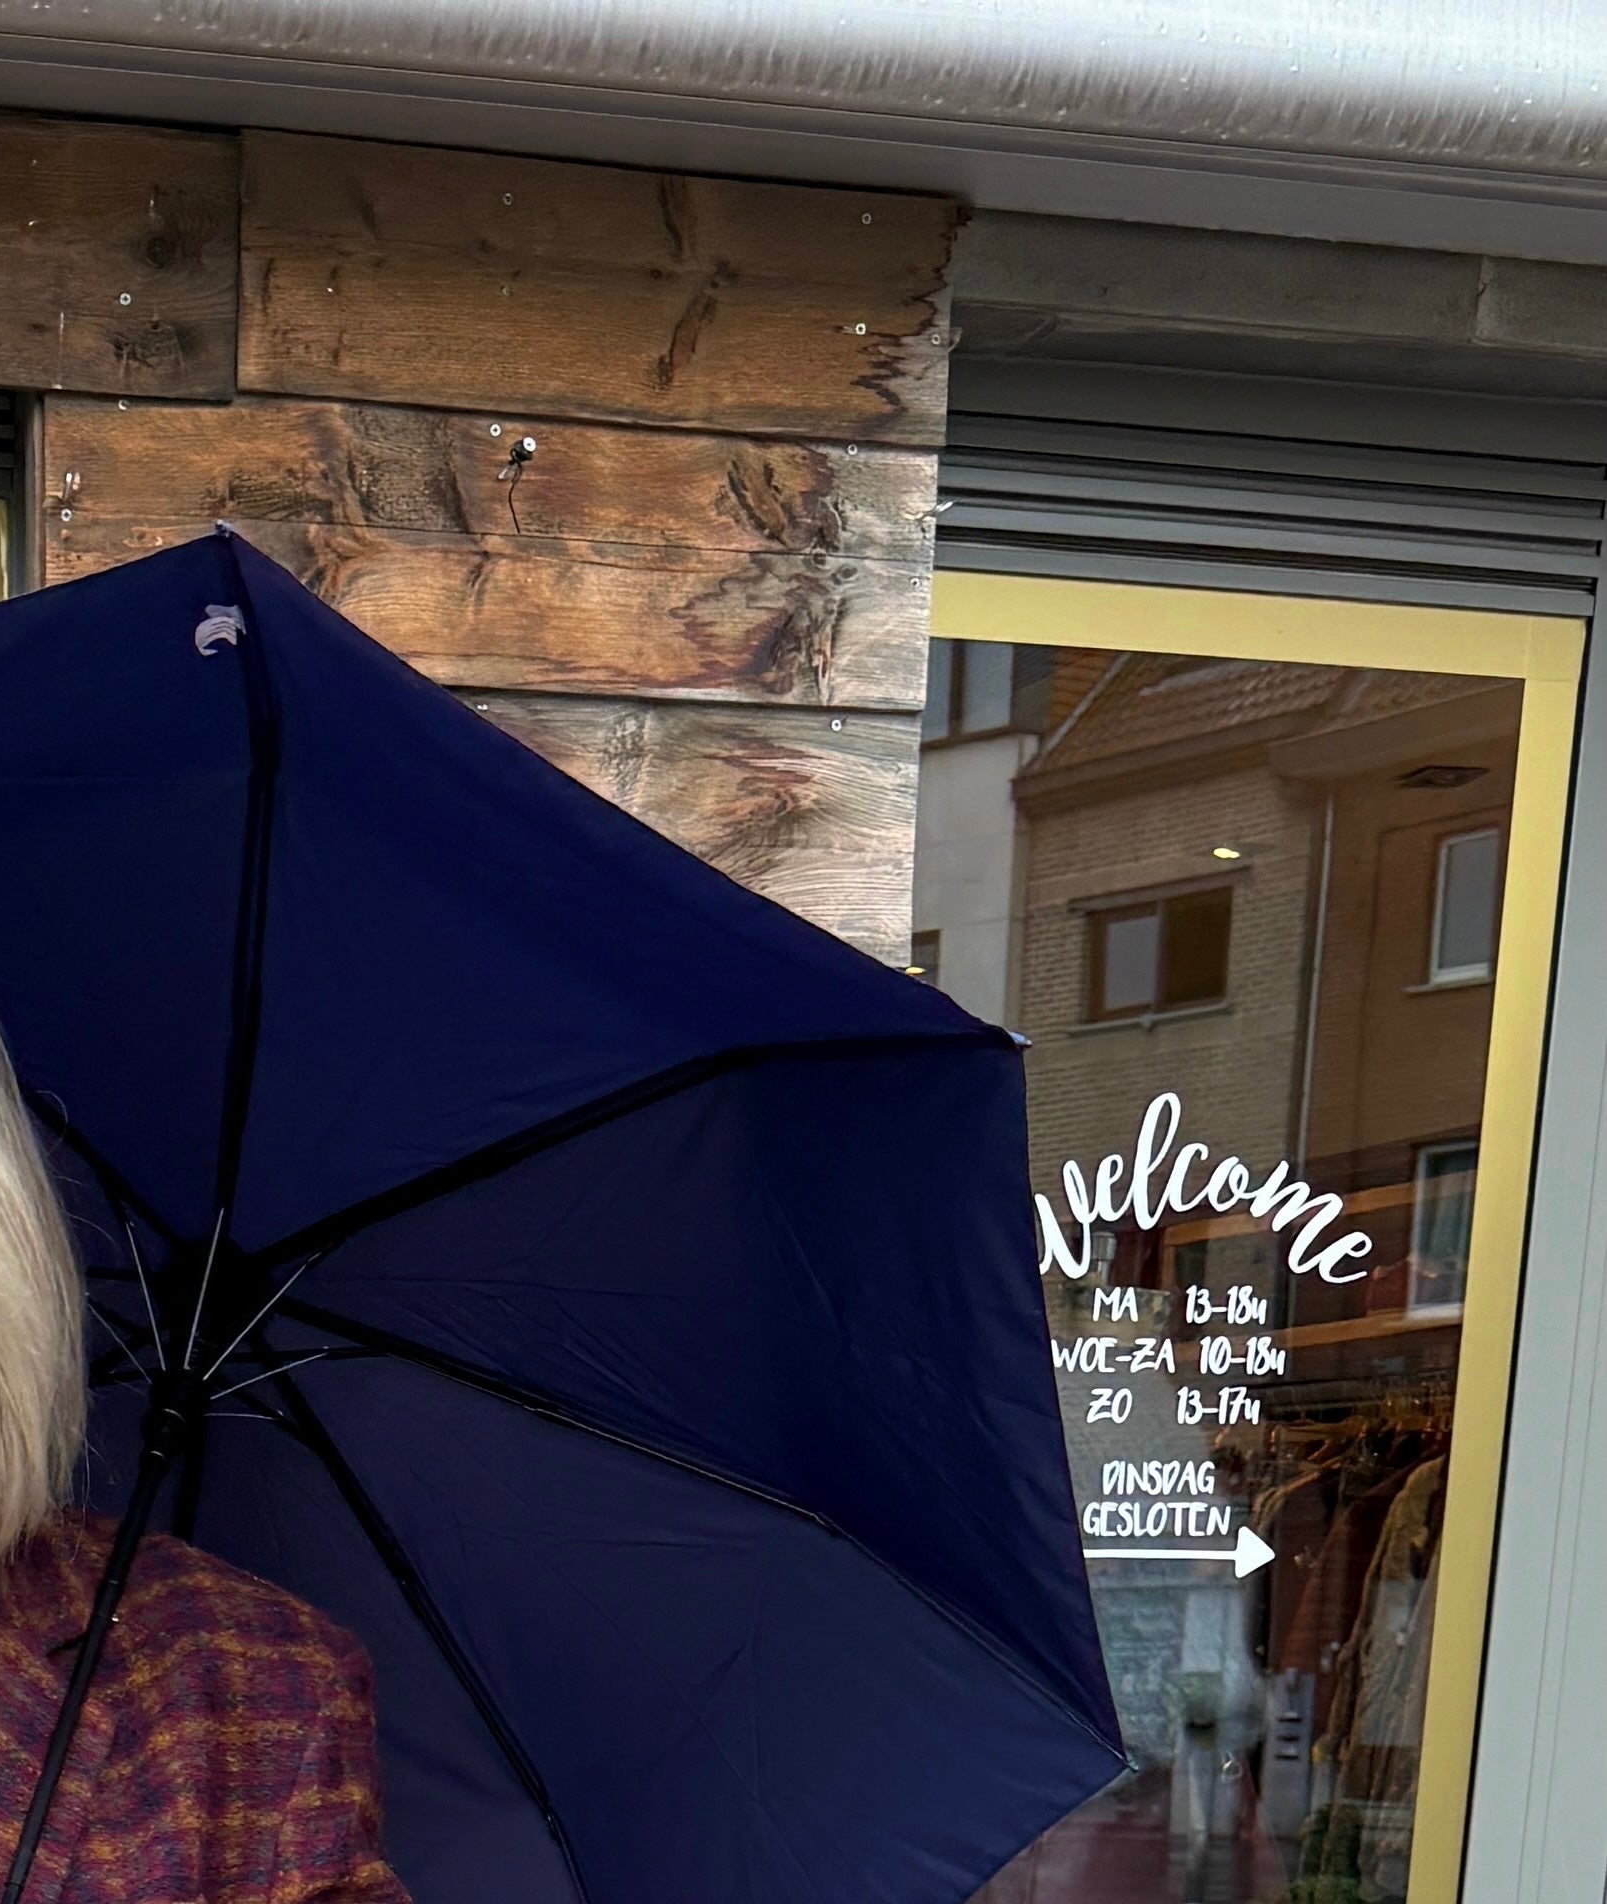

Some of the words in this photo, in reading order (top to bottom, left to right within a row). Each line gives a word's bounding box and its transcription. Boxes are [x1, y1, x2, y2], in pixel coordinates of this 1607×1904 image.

[1034, 1092, 1373, 1284] Welcome
[1092, 1286, 1139, 1322] MA
[1050, 1336, 1176, 1374] WOE-ZA
[1086, 1387, 1133, 1424] ZO
[1102, 1460, 1216, 1496] DINSDAG
[1082, 1501, 1231, 1537] GESLOTEN
